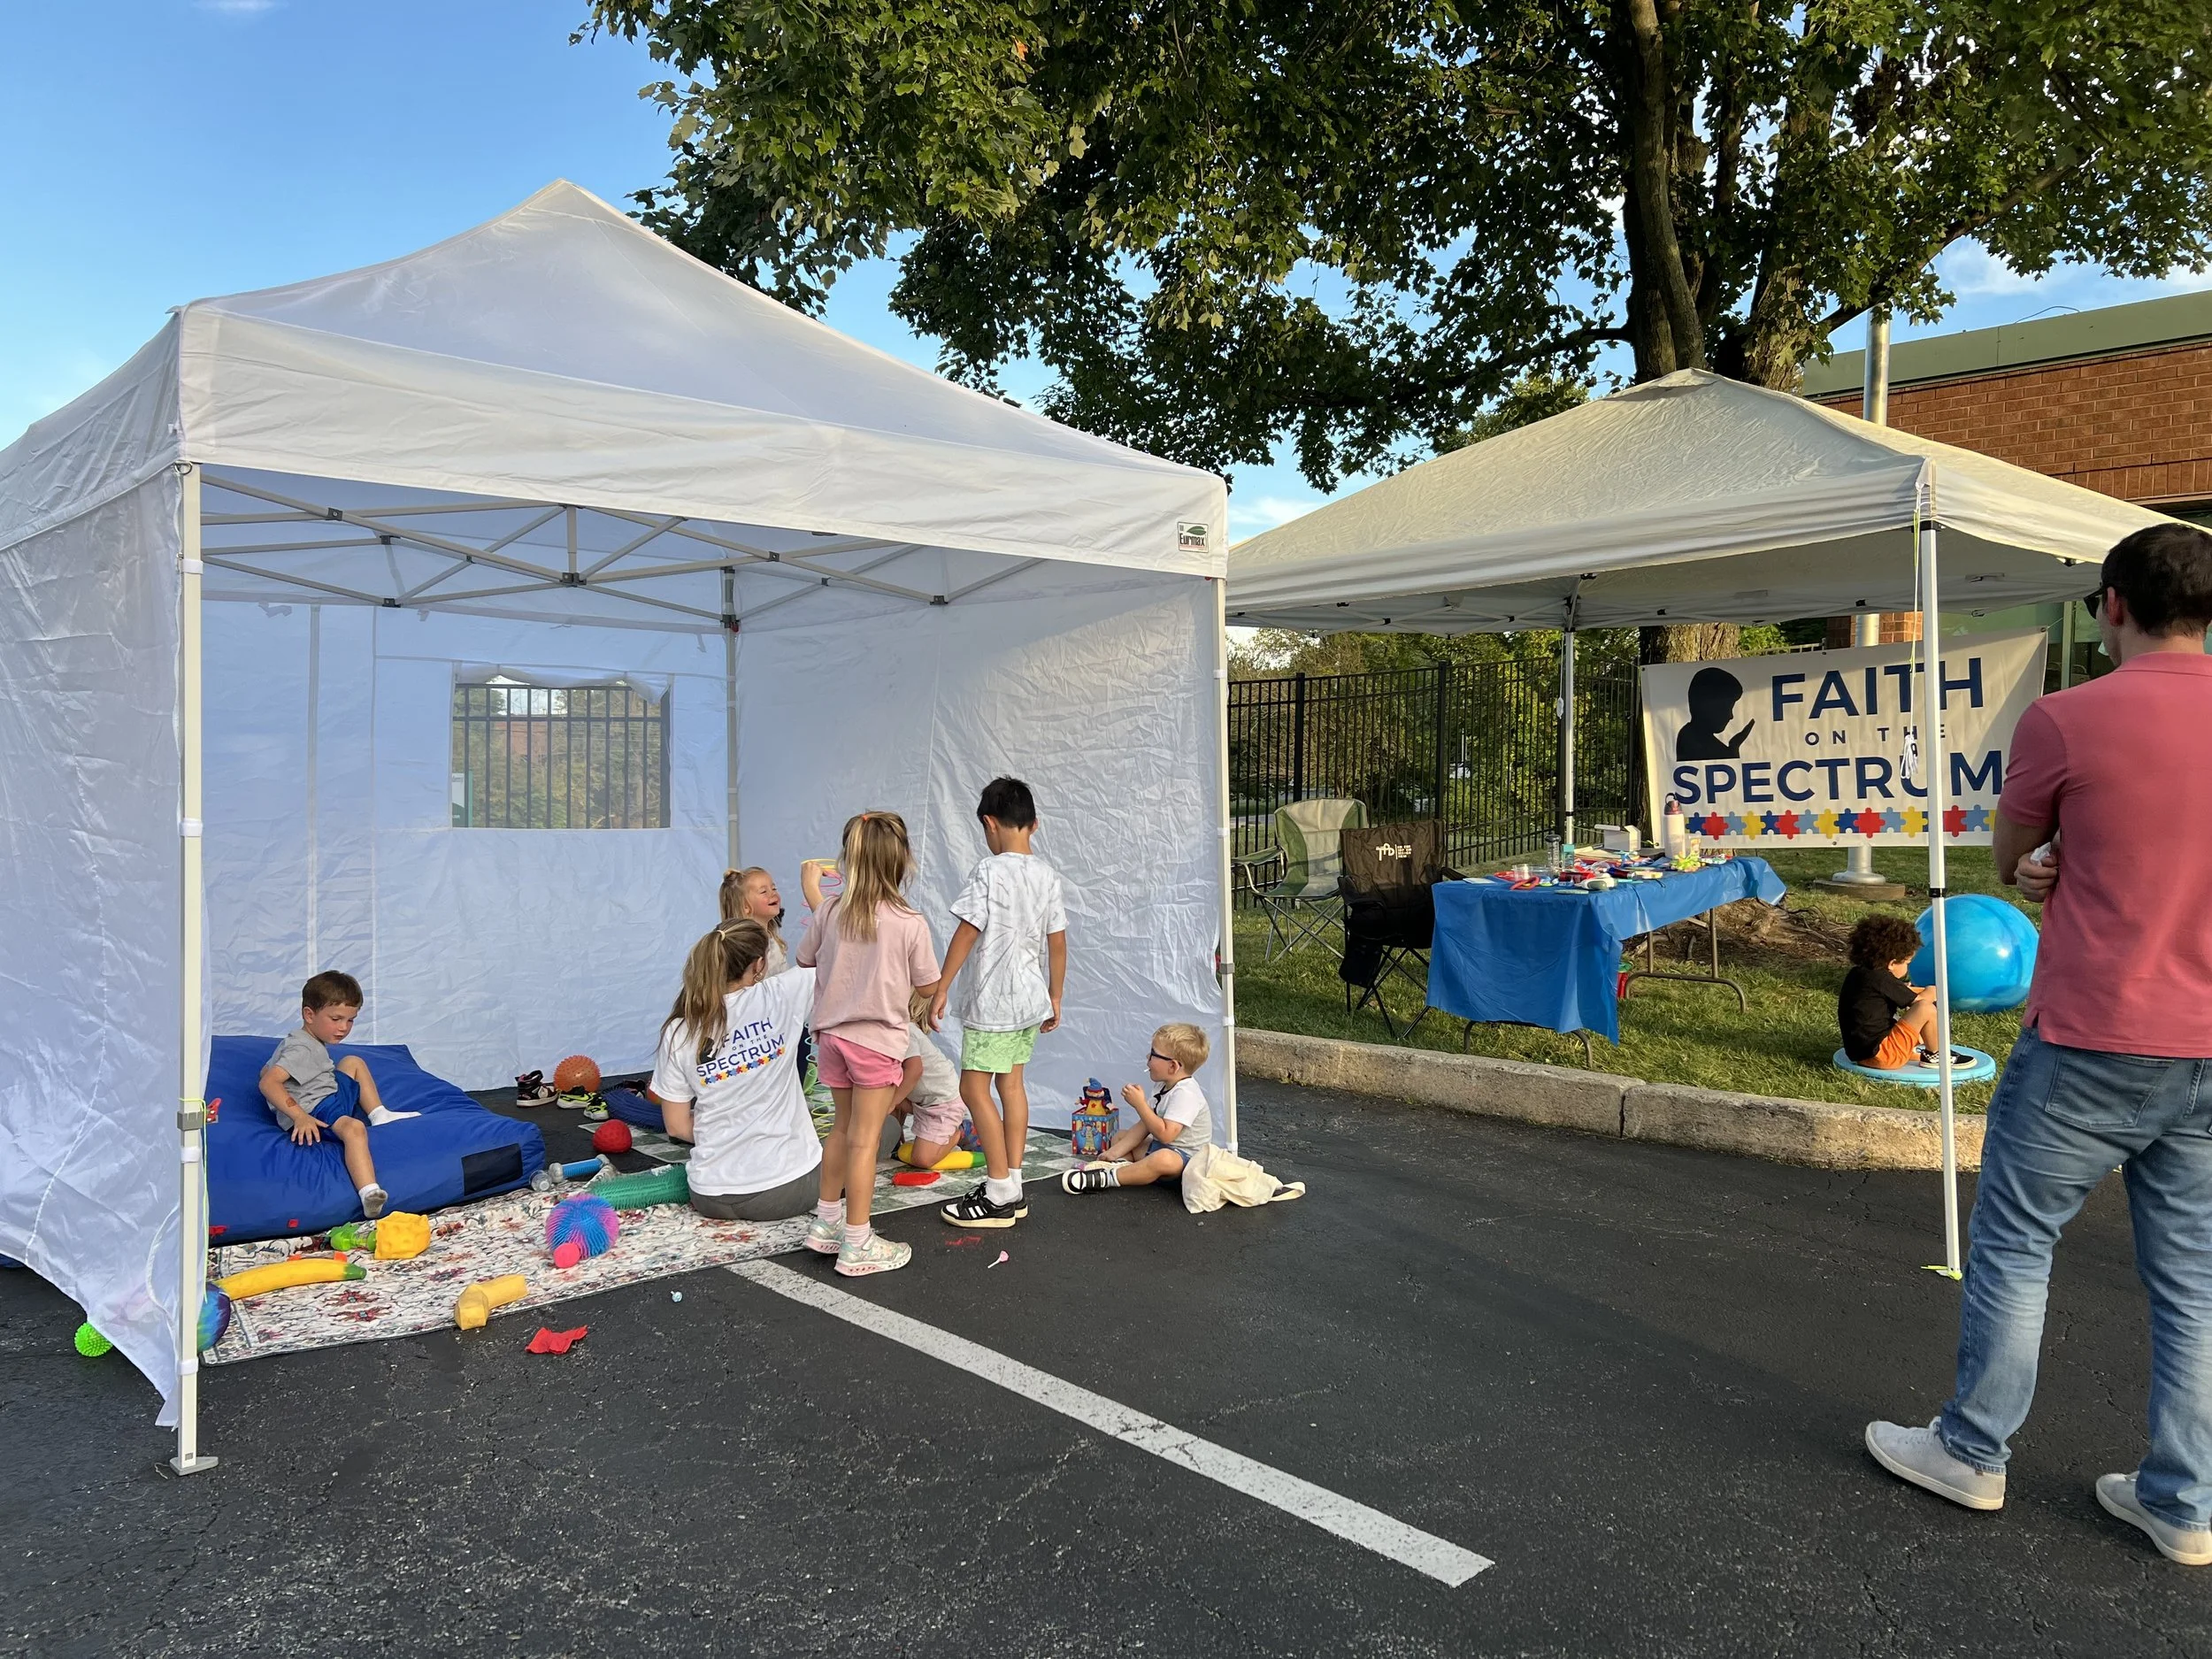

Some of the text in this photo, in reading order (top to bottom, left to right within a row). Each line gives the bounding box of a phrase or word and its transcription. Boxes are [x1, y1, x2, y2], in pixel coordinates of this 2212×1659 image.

[1179, 533, 1205, 546] Eurmax
[1772, 657, 1984, 722] FAITH
[1805, 729, 1847, 746] ON
[721, 1017, 773, 1048] FAITH
[750, 1034, 768, 1044] THE
[696, 1033, 784, 1077] SPECTRUM
